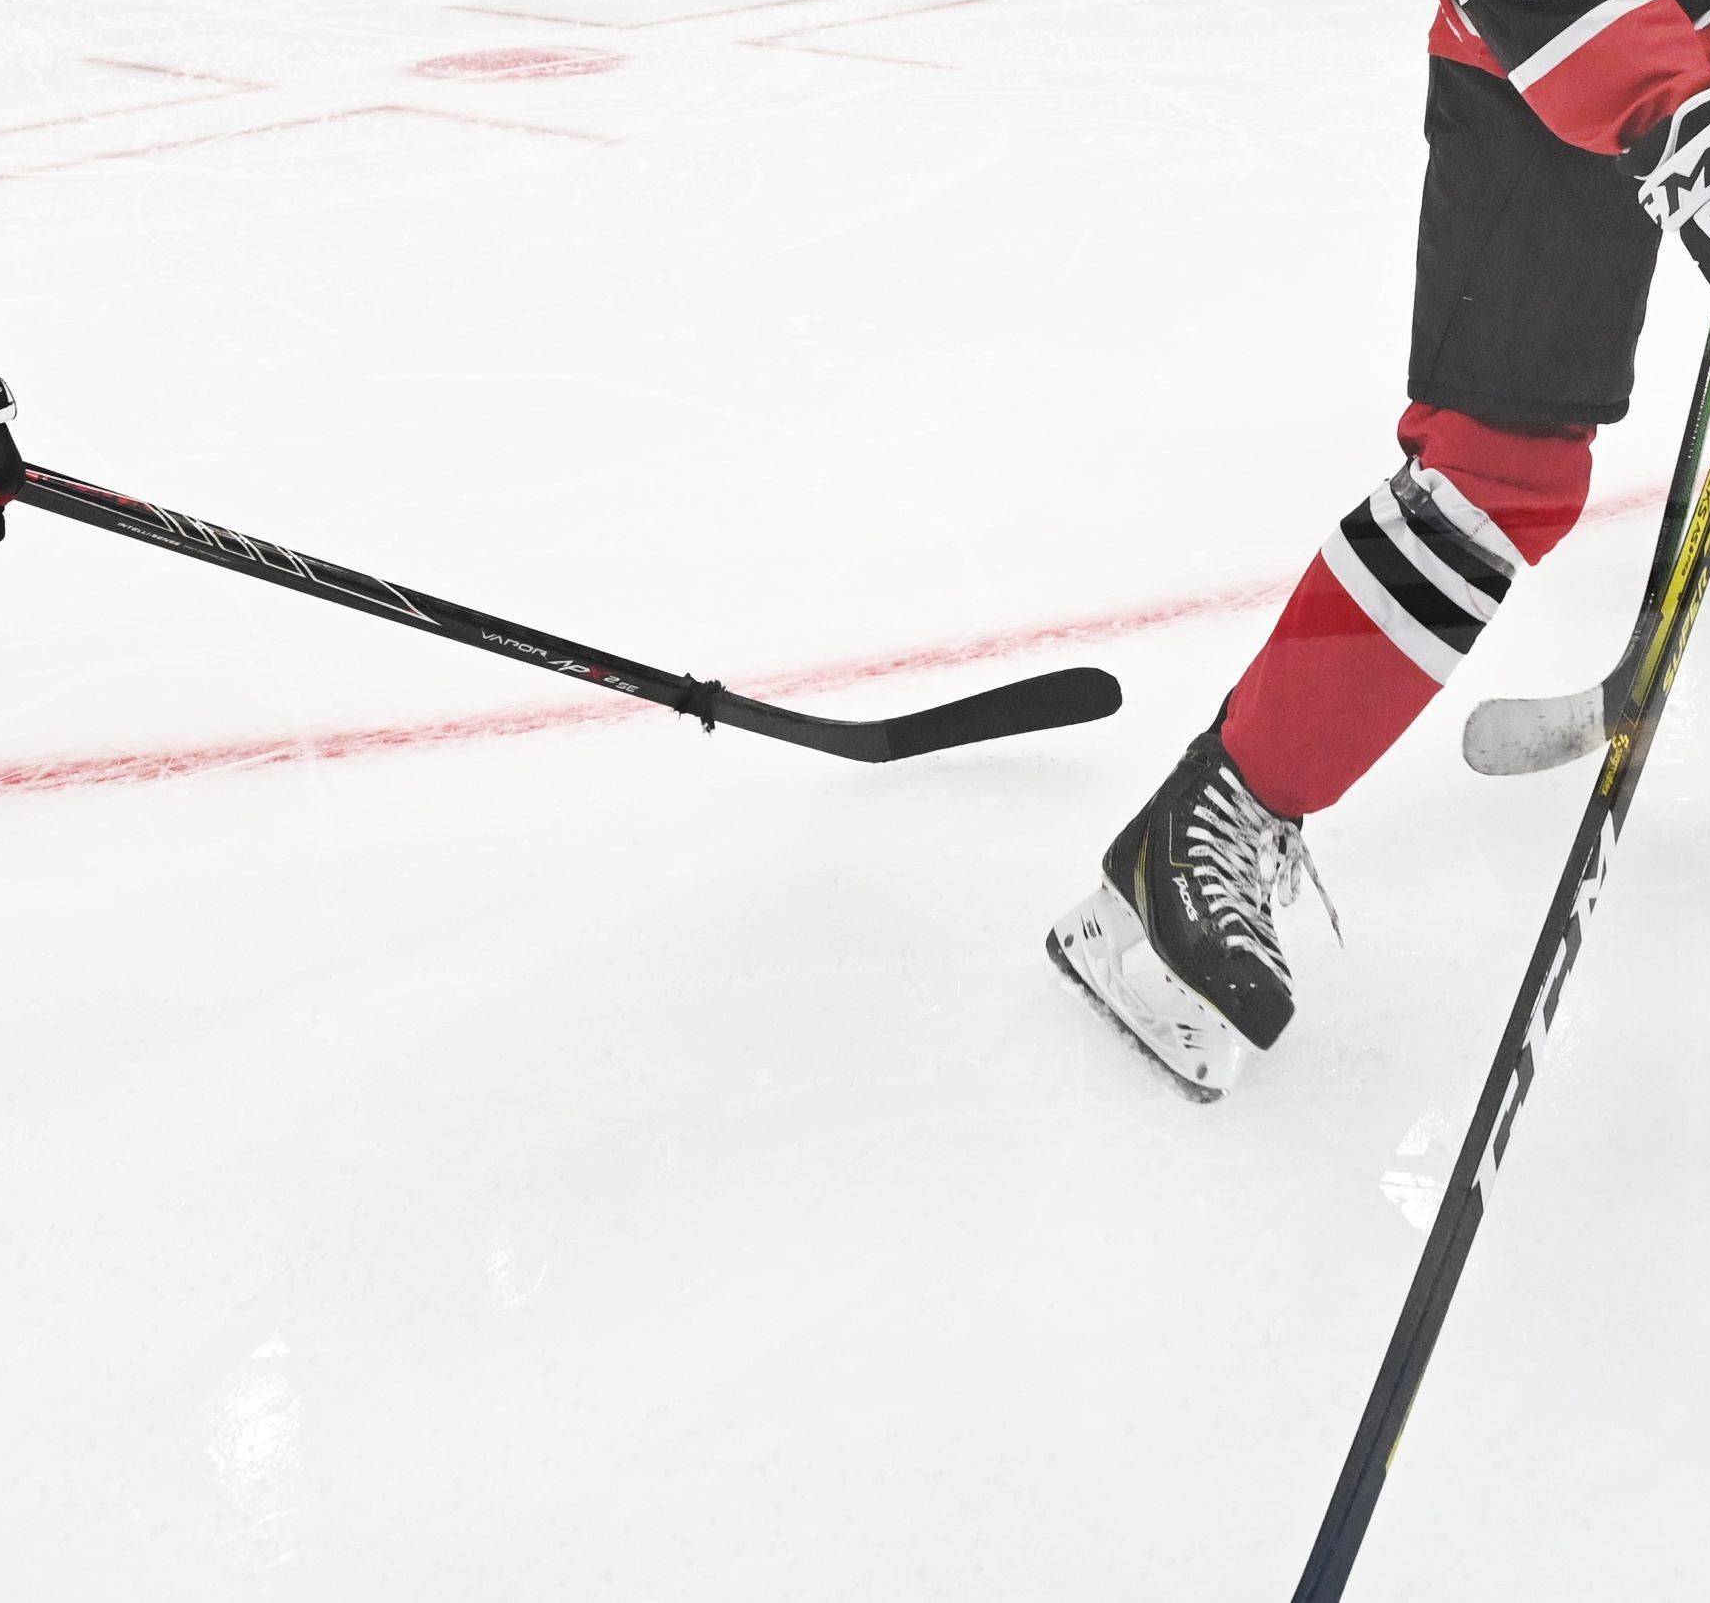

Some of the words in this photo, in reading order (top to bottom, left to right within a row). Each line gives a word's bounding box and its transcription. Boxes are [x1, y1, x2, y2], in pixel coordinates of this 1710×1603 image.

[117, 522, 182, 547] INTELLI-SENSE
[480, 627, 549, 661] VAPOR
[615, 682, 640, 694] SE
[1662, 565, 1708, 698] SUPER
[1171, 872, 1201, 923] TACKS
[1469, 809, 1613, 1190] CCM
